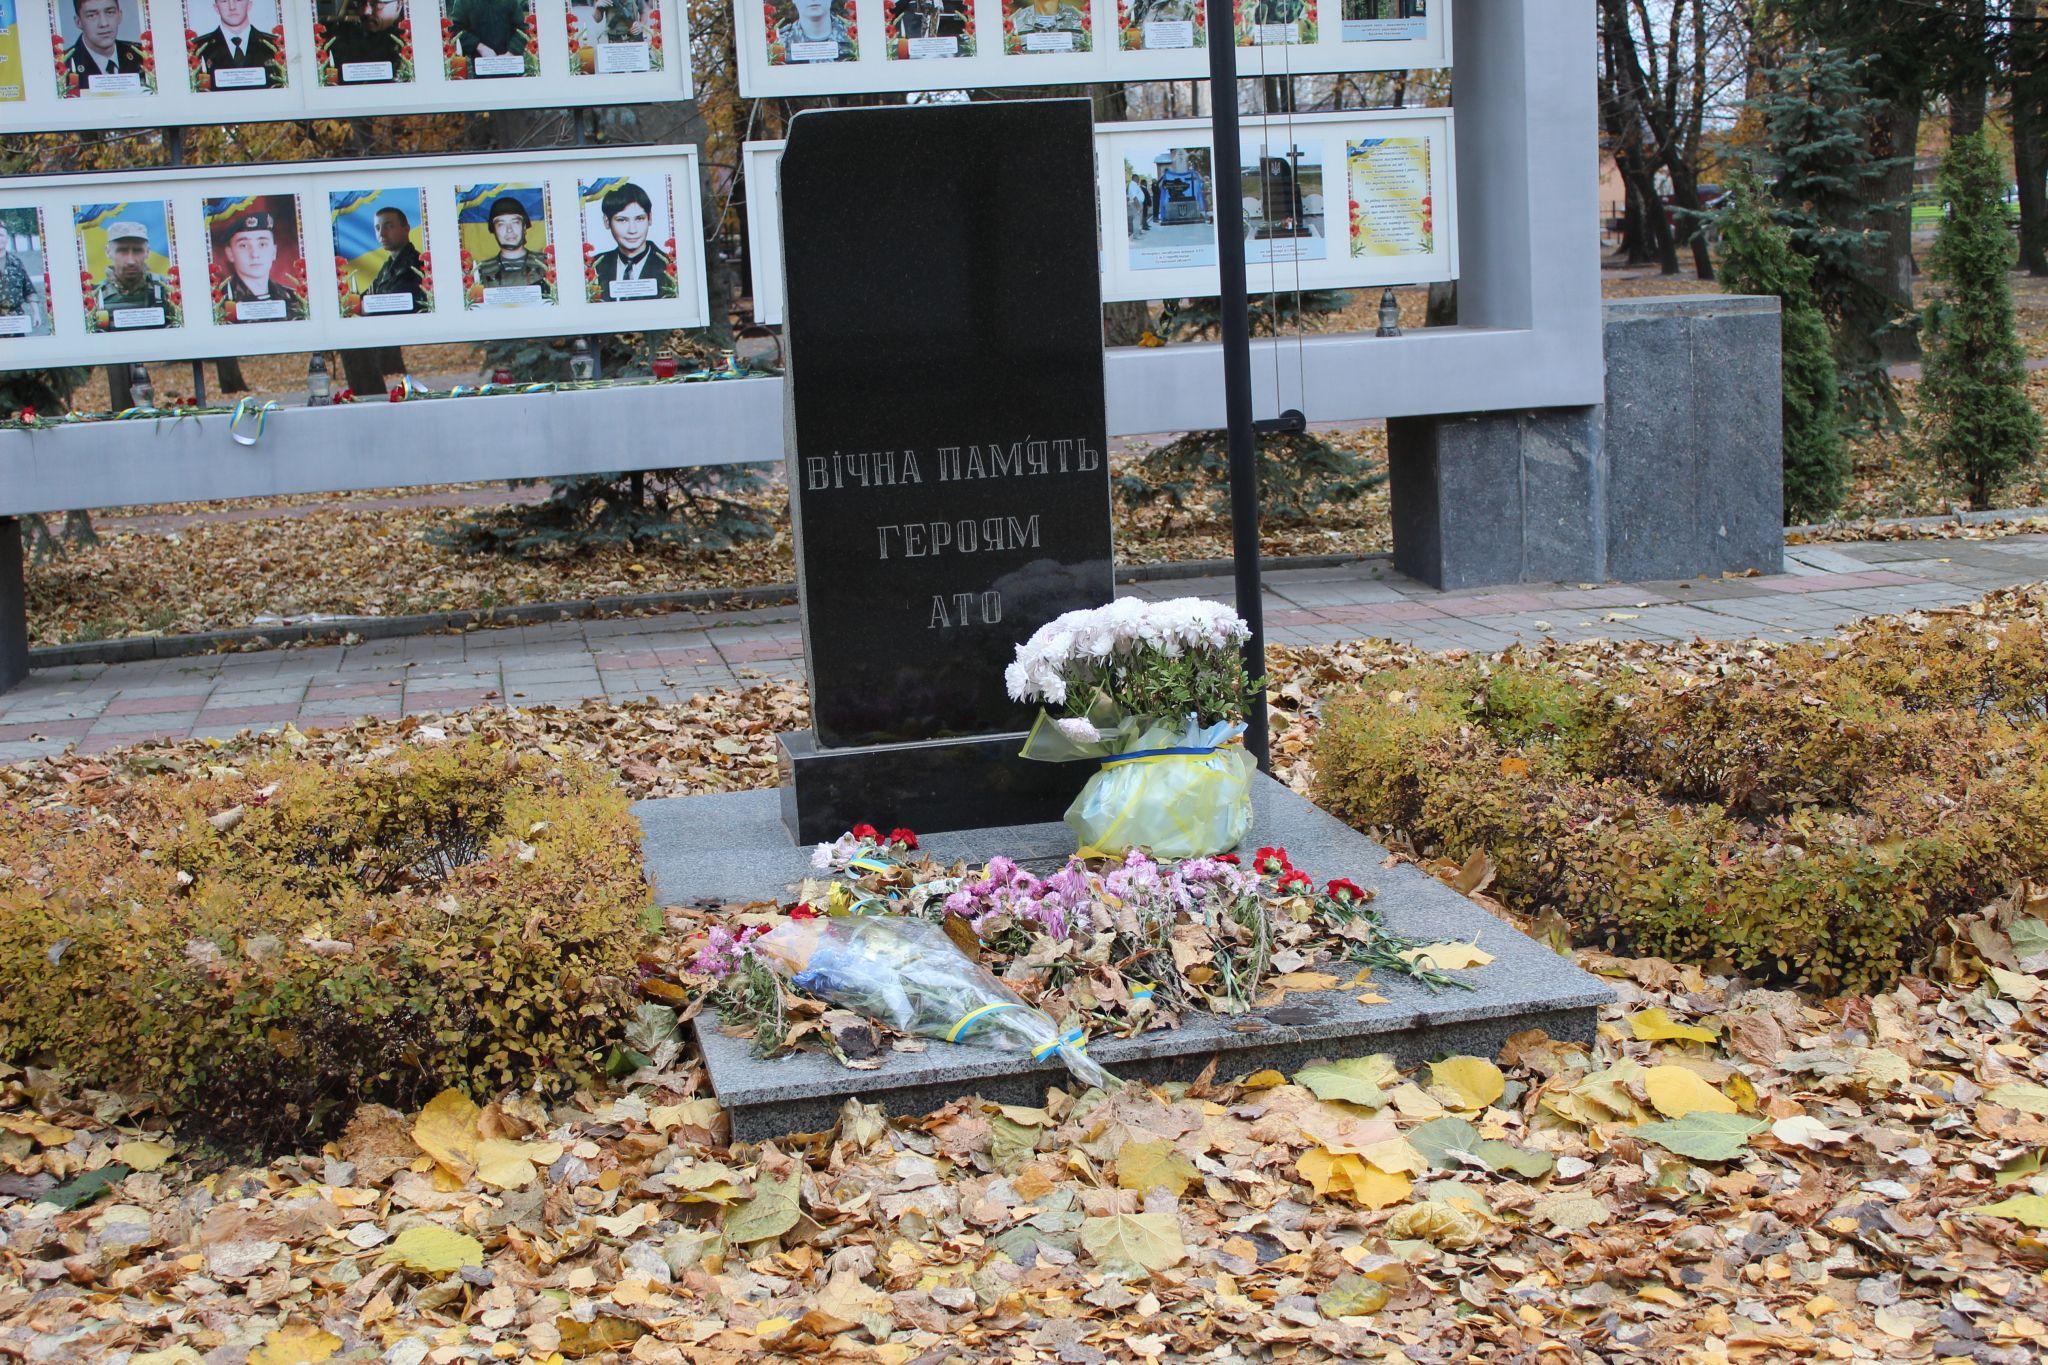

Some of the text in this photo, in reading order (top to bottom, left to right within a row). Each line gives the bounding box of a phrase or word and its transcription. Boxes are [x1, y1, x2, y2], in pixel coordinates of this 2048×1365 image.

[806, 450, 923, 490] ВІЧНА
[877, 515, 1040, 559] ГЕРОЯМ
[927, 591, 1002, 629] АТО
